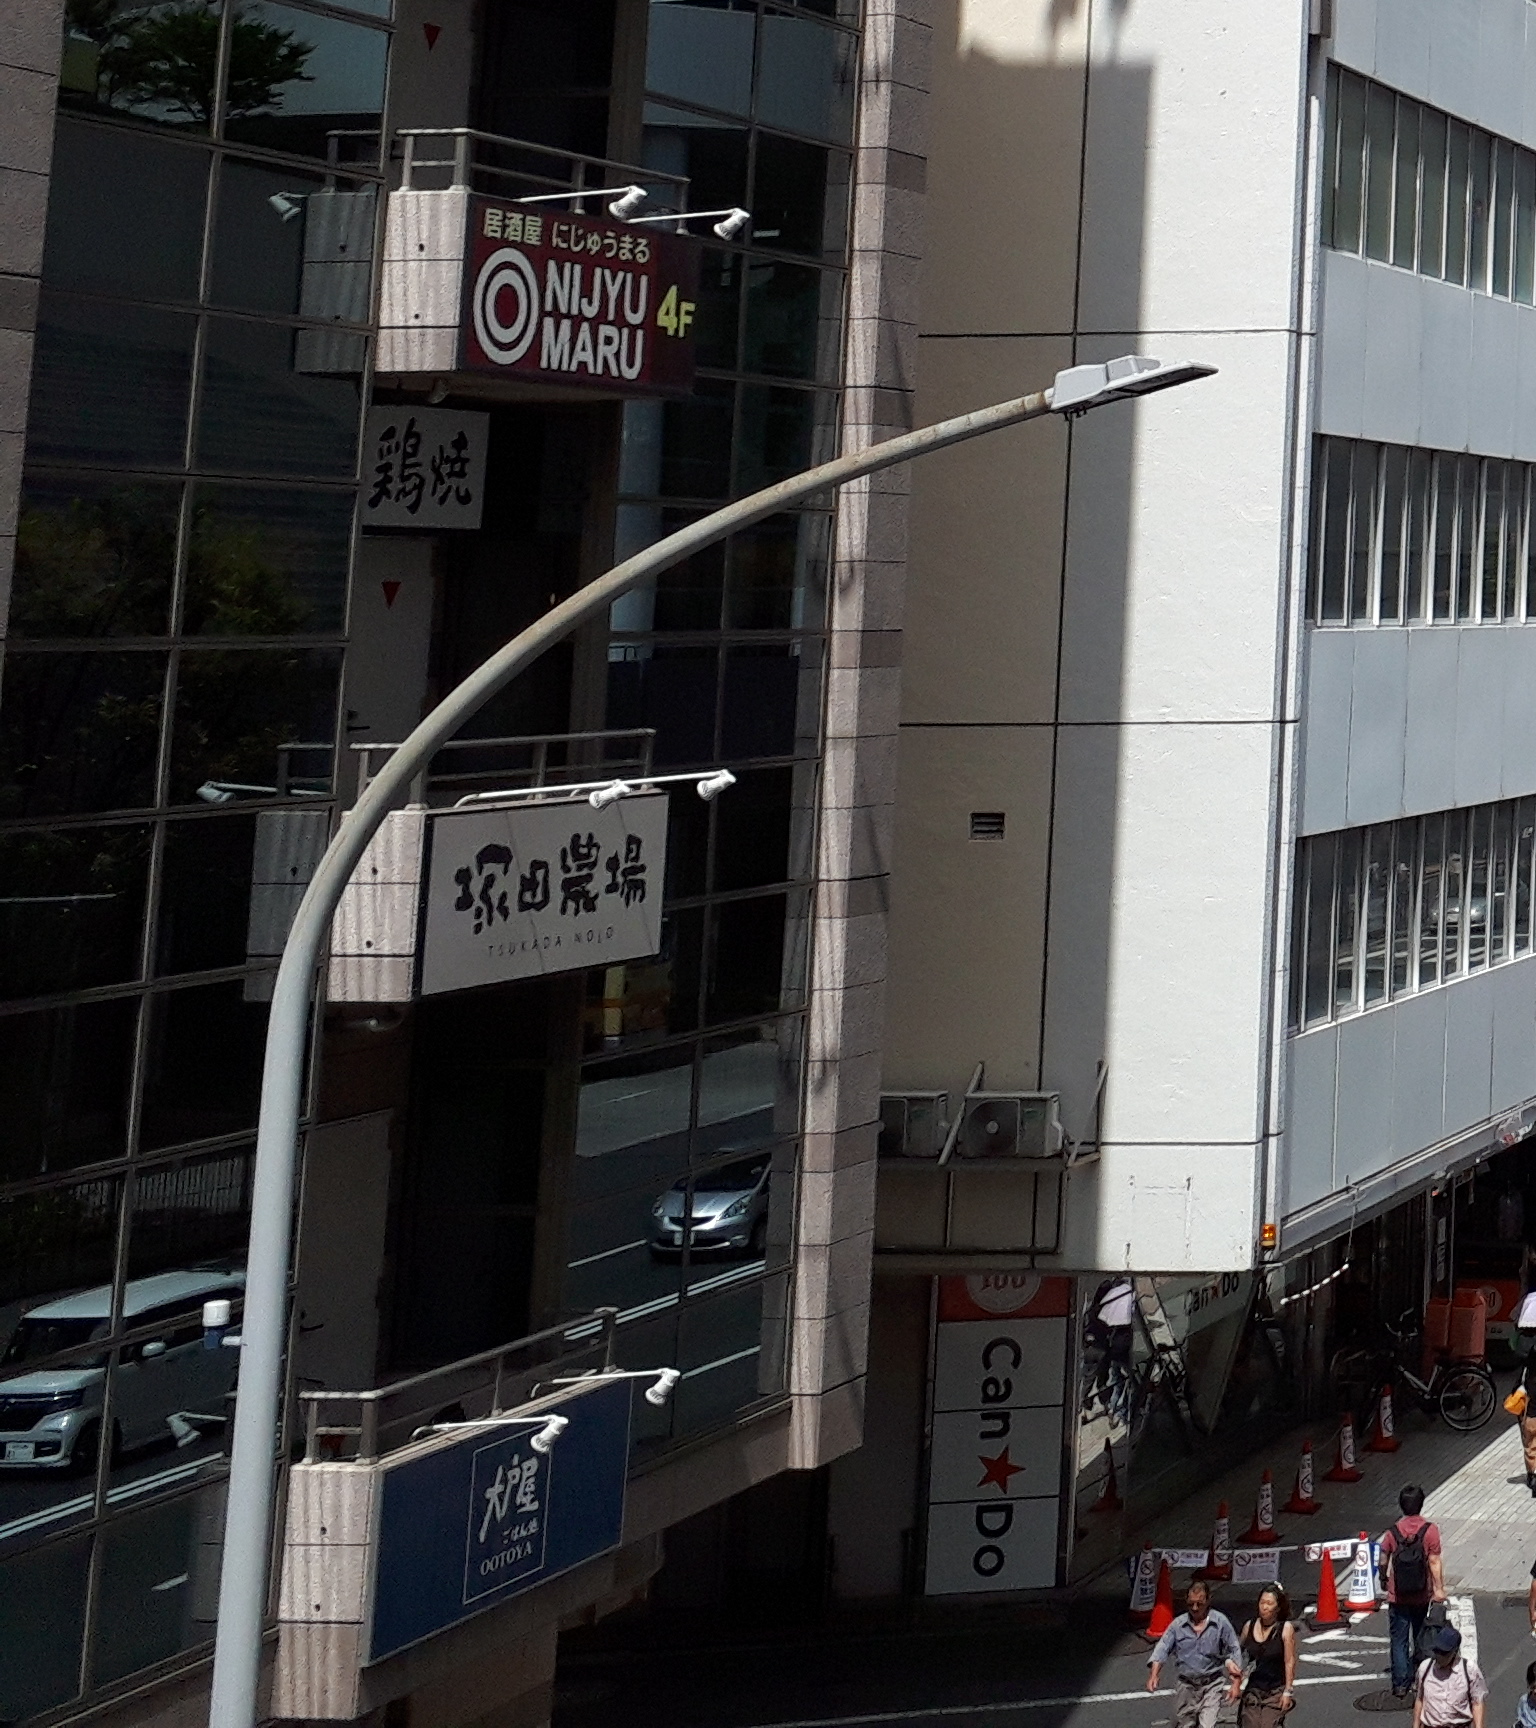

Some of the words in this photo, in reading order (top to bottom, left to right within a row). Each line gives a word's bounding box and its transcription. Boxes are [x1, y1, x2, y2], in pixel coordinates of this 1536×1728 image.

[482, 206, 543, 247] 居酒屋
[551, 221, 651, 264] にじゅうまる
[544, 259, 649, 327] NIJYU
[656, 284, 696, 340] 4F
[540, 315, 644, 381] MARU
[454, 832, 647, 935] 塚田農場
[978, 1335, 1023, 1441] Can
[478, 1453, 540, 1544] 大戸屋
[480, 1540, 533, 1576] OOTOYA
[972, 1503, 1014, 1579] Do
